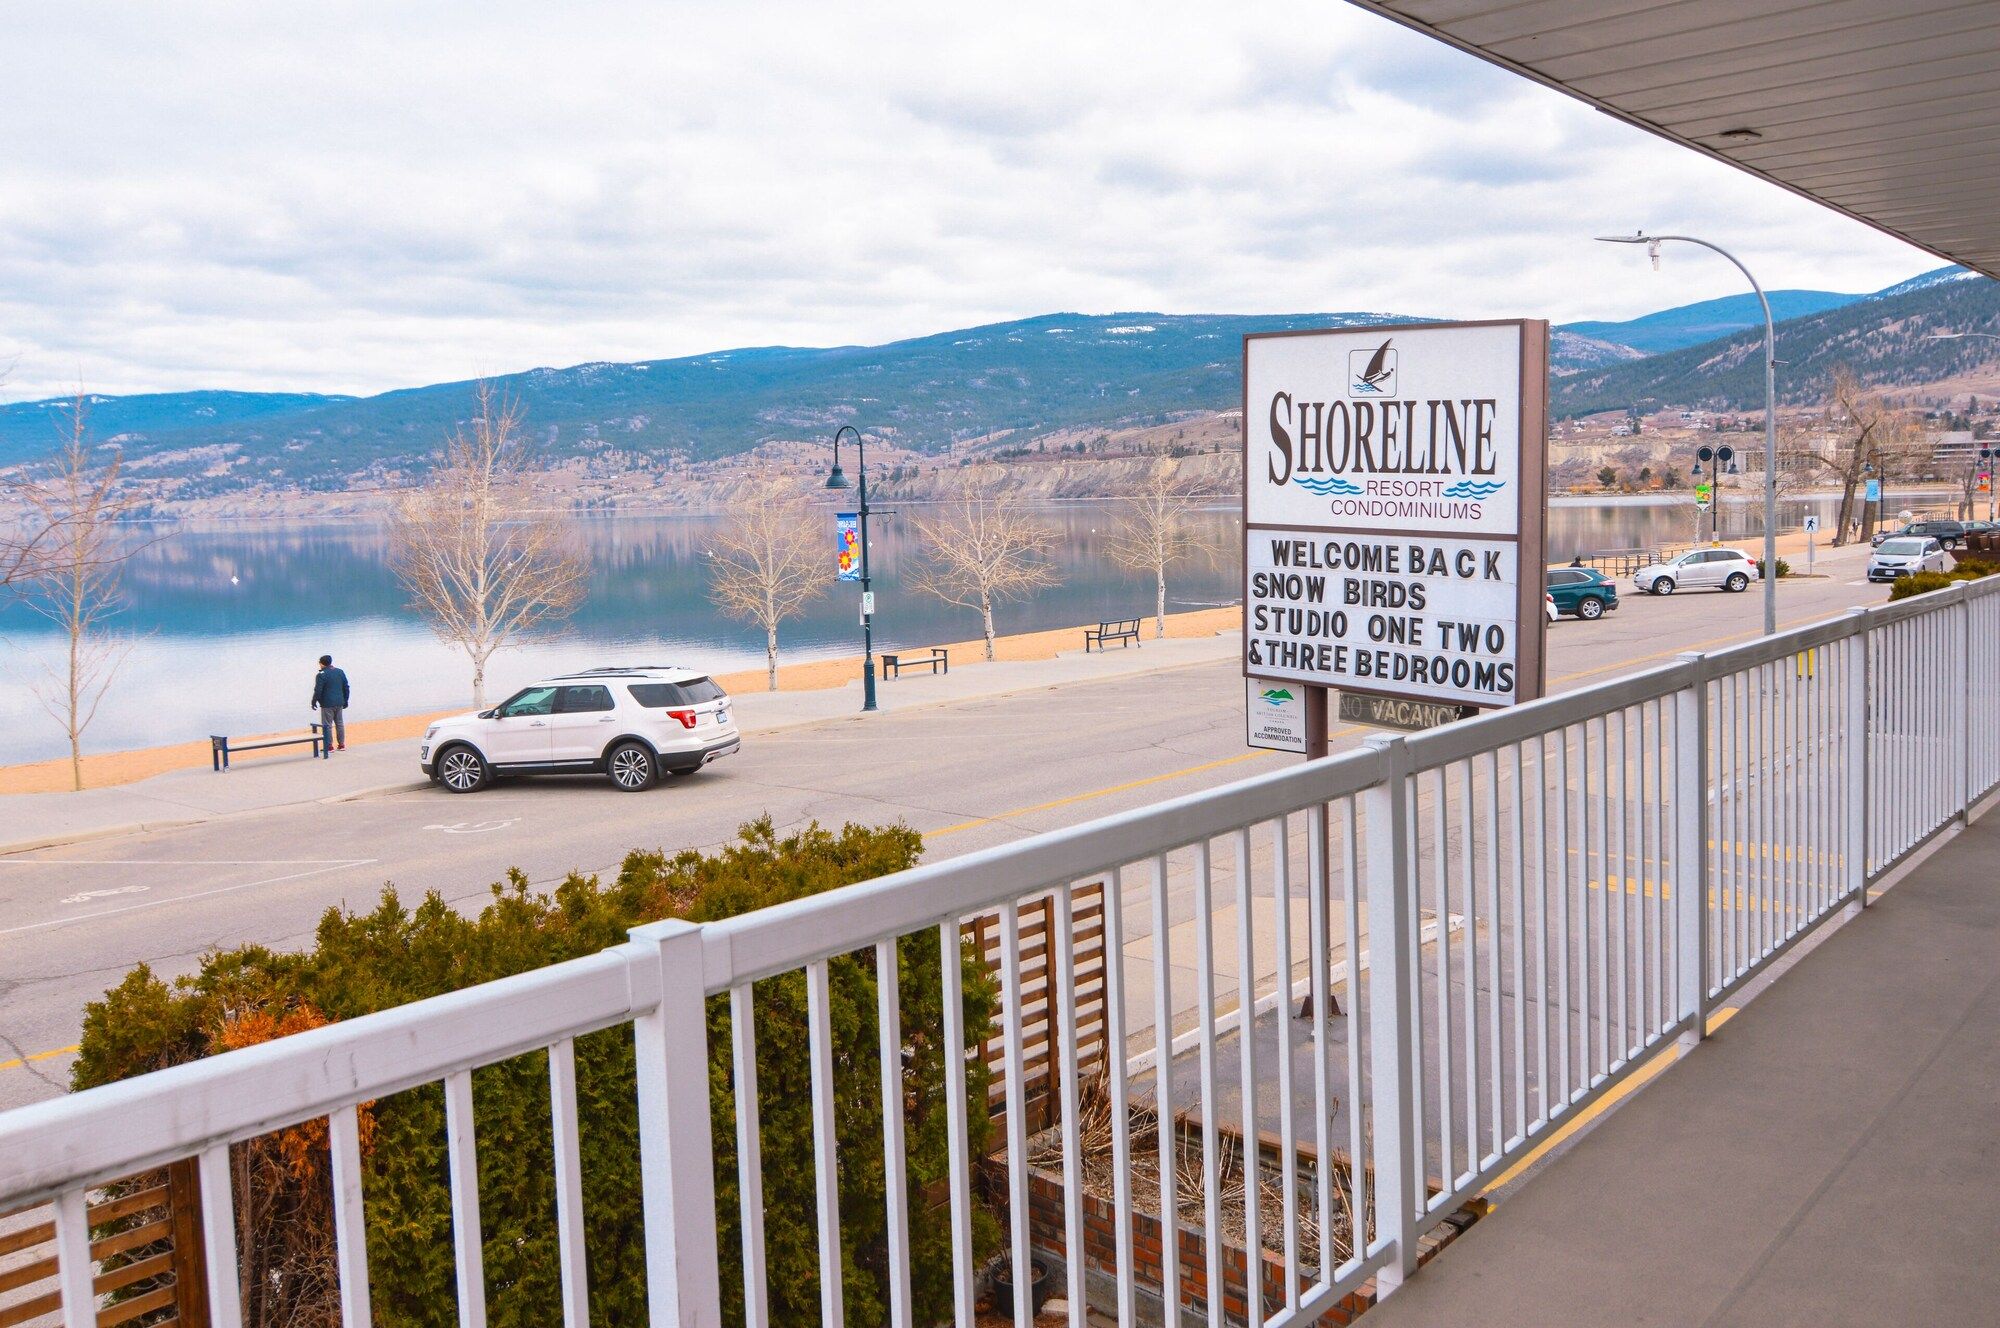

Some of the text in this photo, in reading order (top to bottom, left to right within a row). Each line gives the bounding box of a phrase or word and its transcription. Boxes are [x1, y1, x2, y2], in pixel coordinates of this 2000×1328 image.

[1268, 391, 1496, 486] SHORELINE
[1366, 480, 1444, 497] RESORT
[1331, 500, 1482, 520] CONDOMINIUMS
[1271, 539, 1501, 580] WELCOME BACK
[1252, 572, 1426, 610] SNOW BIRDS
[1254, 604, 1505, 654] STUDIO ONE TWO
[1354, 649, 1514, 693] BEDROOMS
[1253, 732, 1302, 744] ACCOMMODATION
[1263, 726, 1292, 735] APPROVED
